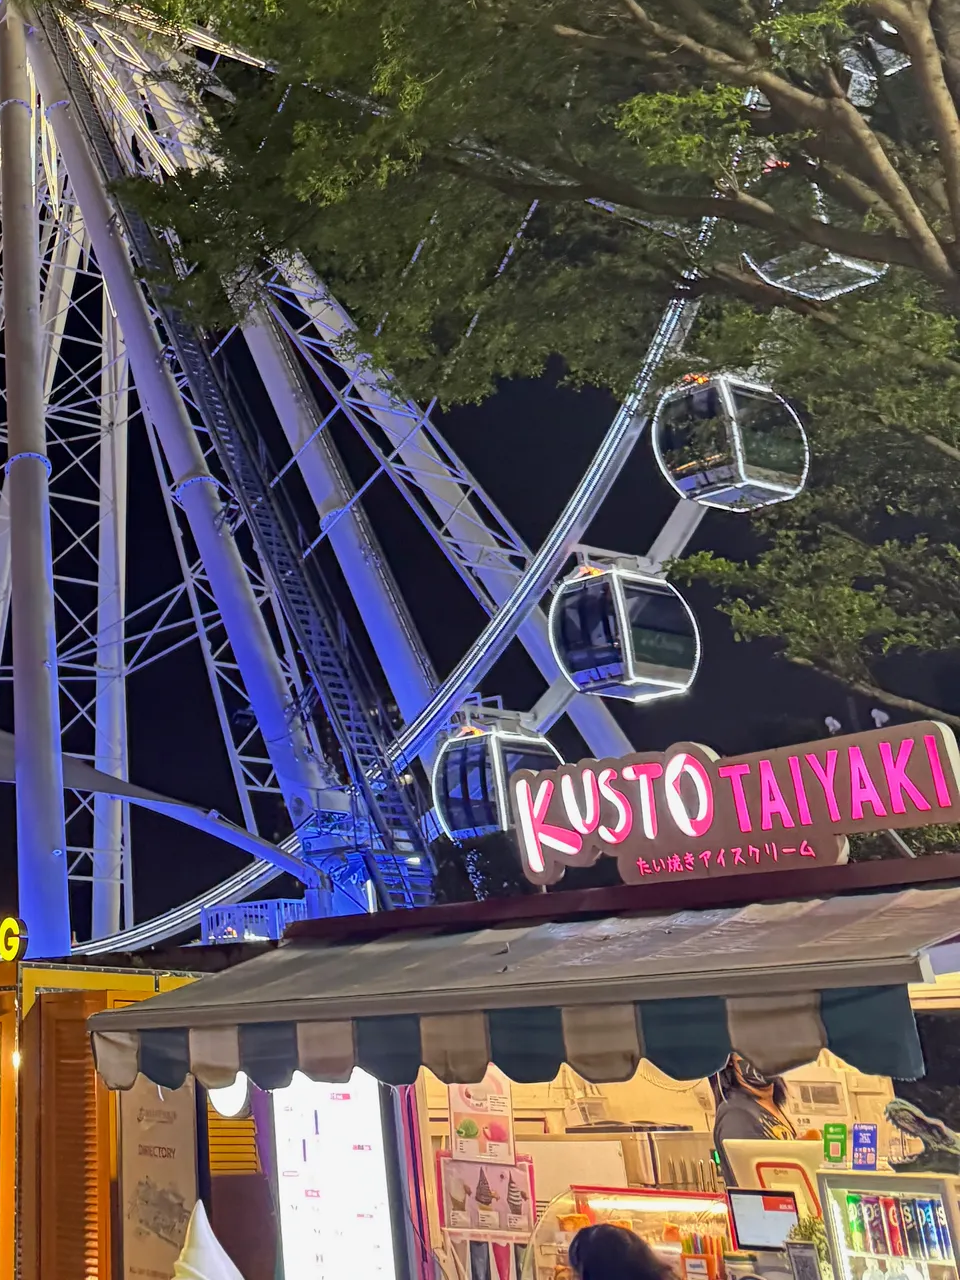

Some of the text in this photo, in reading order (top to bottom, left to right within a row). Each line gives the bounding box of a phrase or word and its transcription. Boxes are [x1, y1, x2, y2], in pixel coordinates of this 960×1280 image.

[516, 735, 951, 873] KUSTO TAIYAKI
[636, 839, 817, 876] たい焼きアイスクリーム
